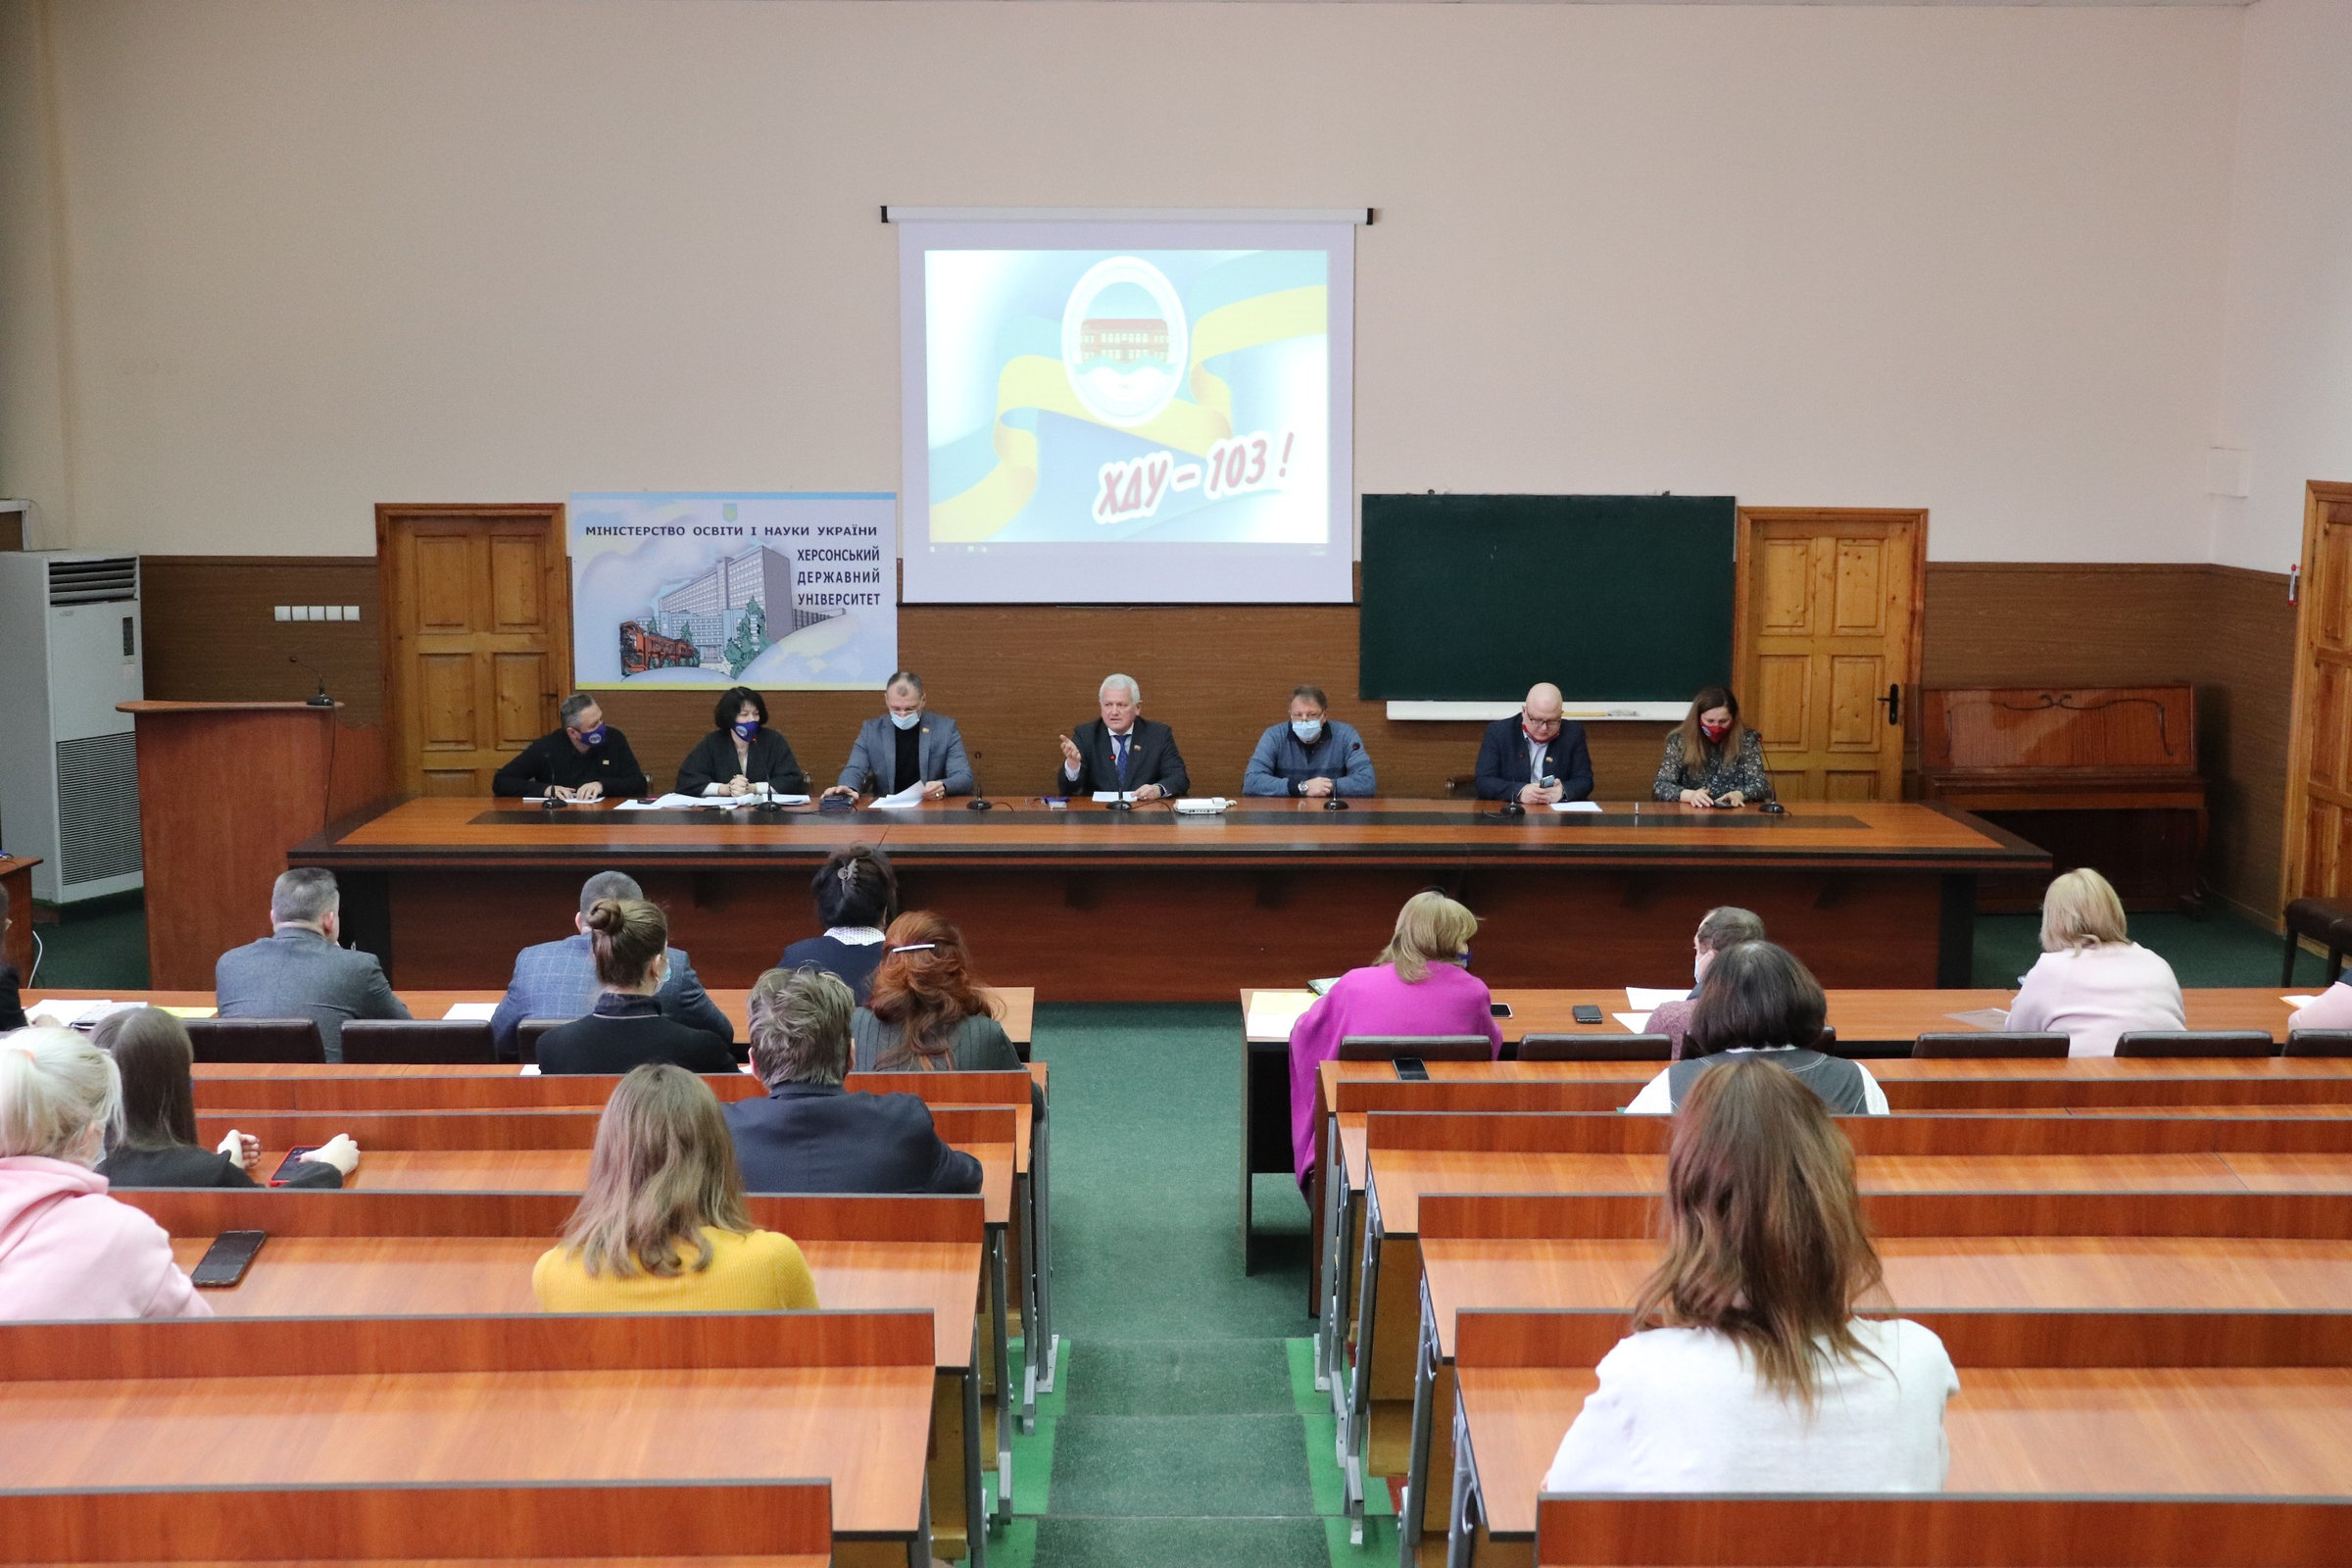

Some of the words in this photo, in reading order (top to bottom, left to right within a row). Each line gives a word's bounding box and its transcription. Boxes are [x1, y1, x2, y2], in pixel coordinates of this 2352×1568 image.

[1098, 459, 1168, 516] ХДУ
[1209, 438, 1268, 492] 103
[585, 526, 686, 536] МІНІСТЕРСТВО
[693, 526, 744, 536] ОСВІТИ
[751, 526, 758, 536] І
[764, 526, 810, 536] НАУКИ
[817, 523, 878, 536] УКРАЇНИ
[797, 545, 880, 562] ХЕРСОНСЬКИЙ
[797, 567, 880, 585] ДЕРЖАВНИЙ
[798, 593, 881, 606] УНІВЕРСИТЕТ
